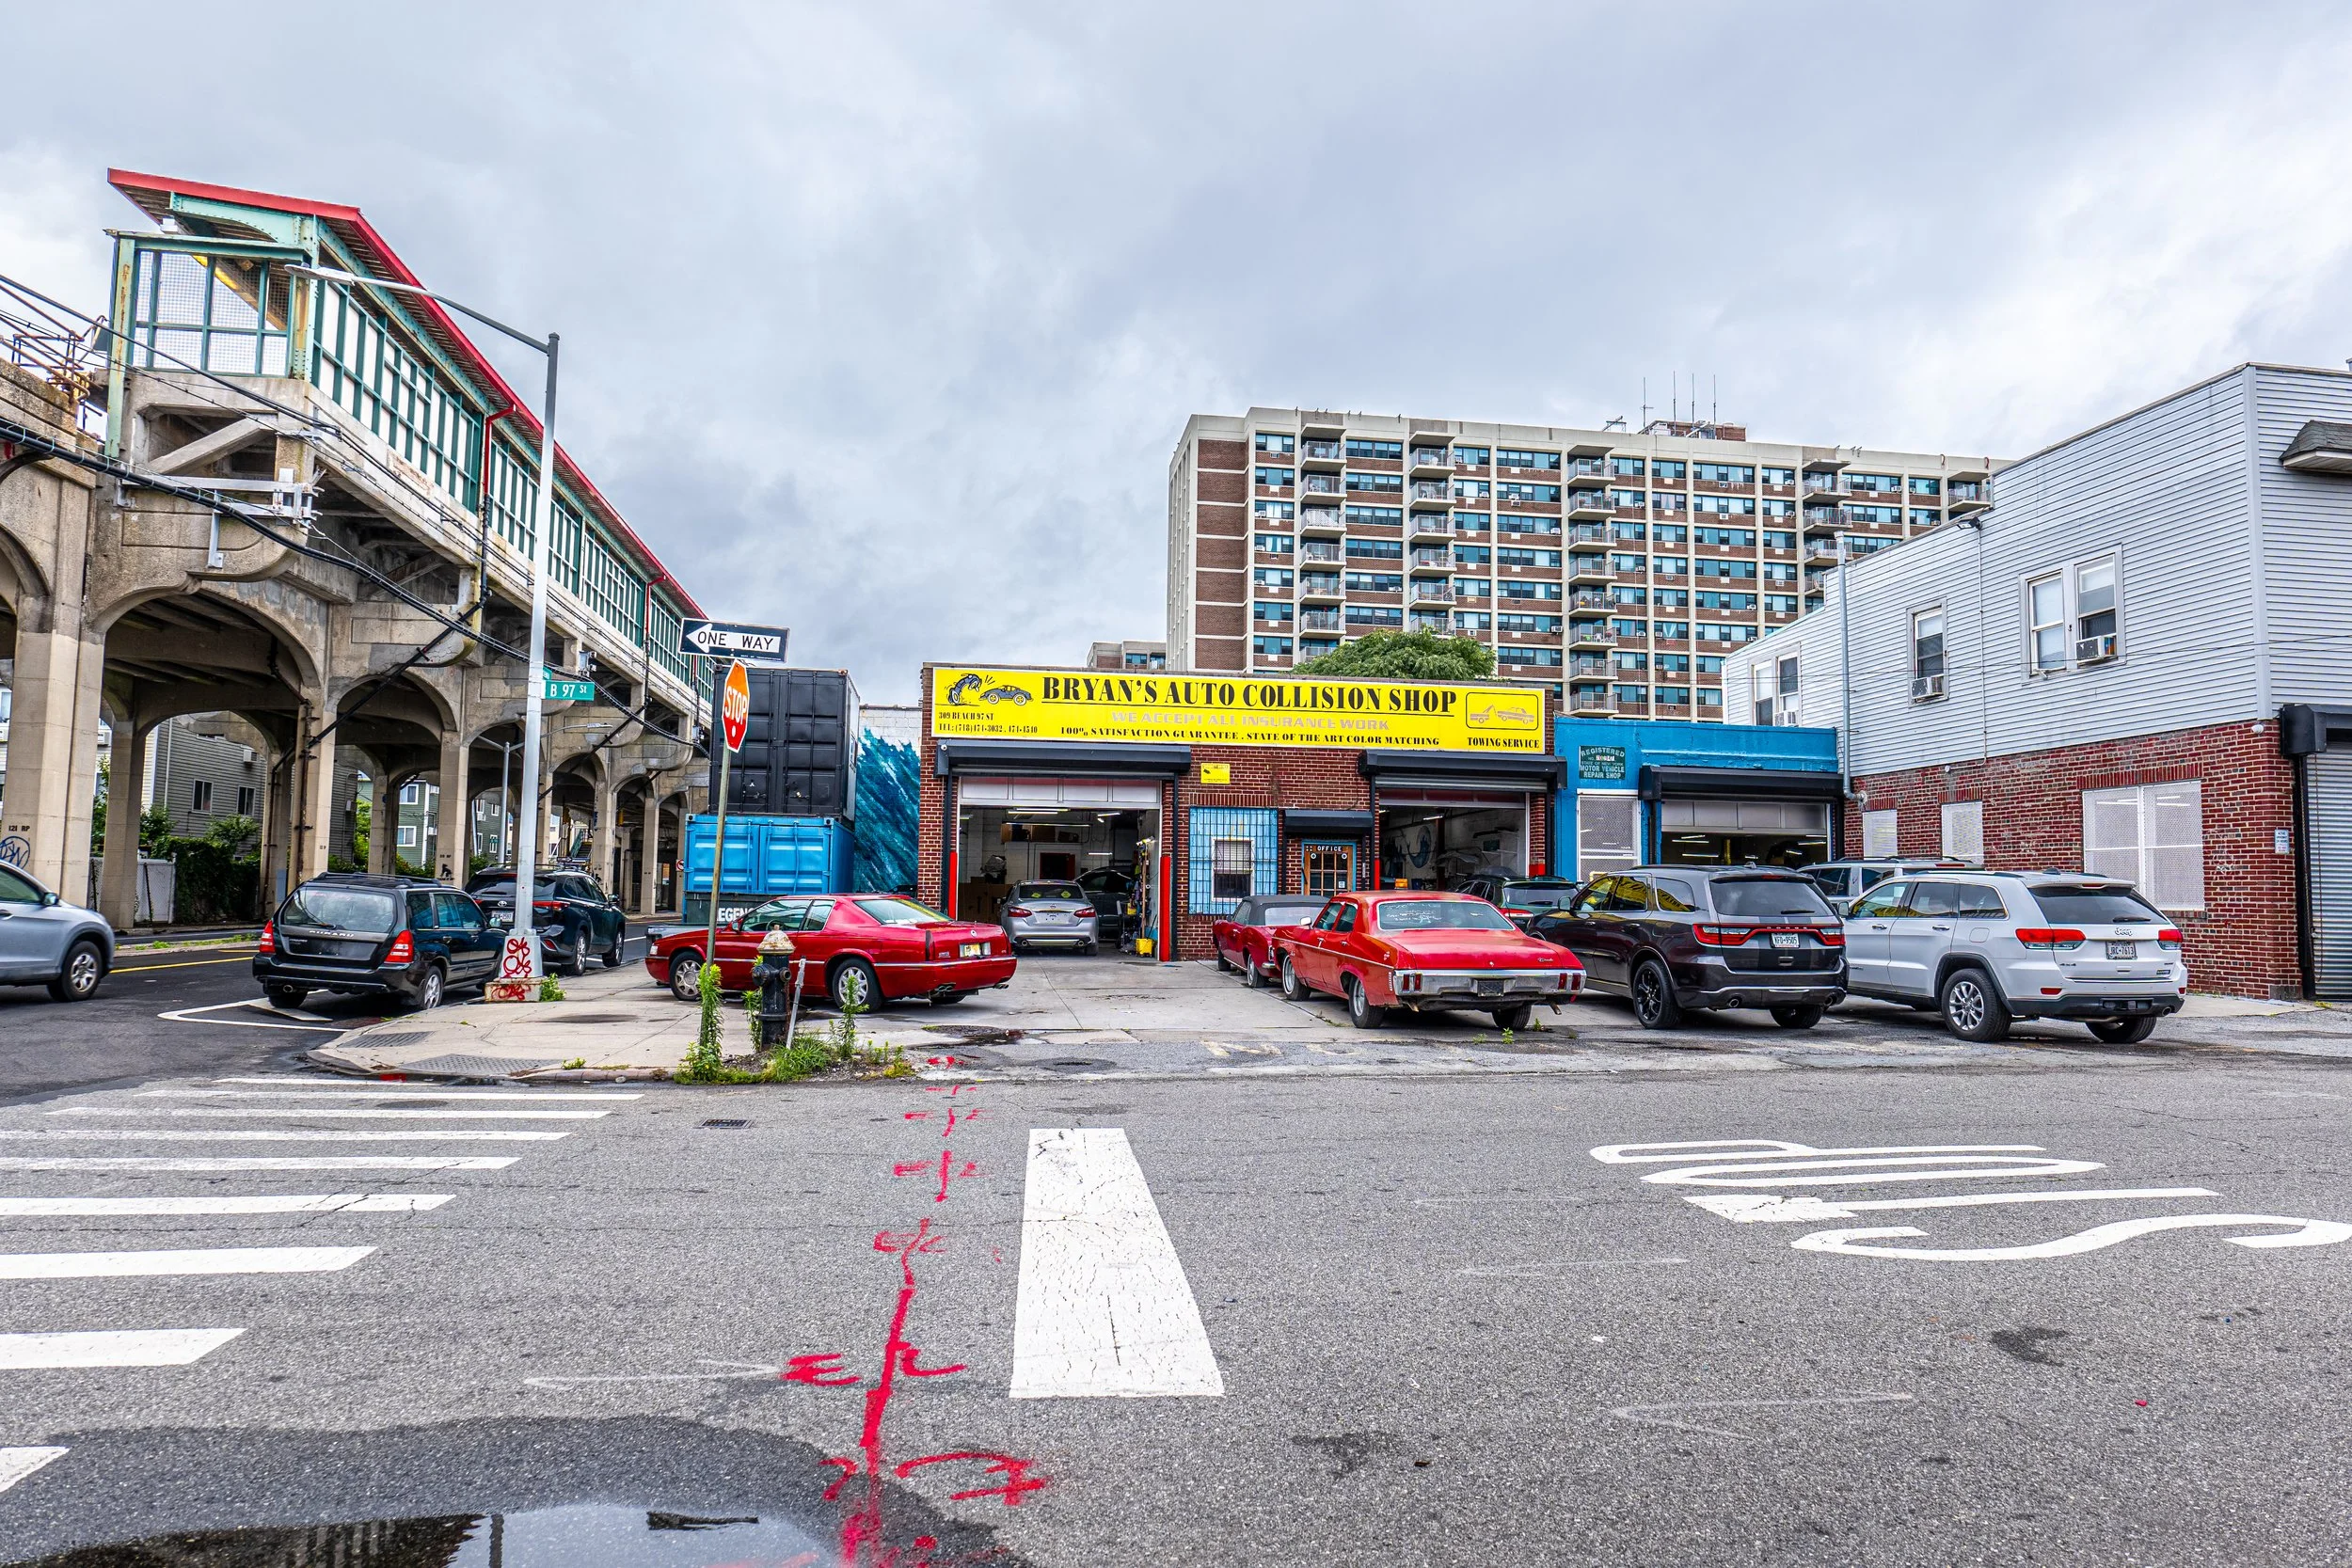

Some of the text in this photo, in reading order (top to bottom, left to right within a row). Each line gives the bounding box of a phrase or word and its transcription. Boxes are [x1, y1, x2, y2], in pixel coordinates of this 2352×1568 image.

[697, 631, 774, 650] ONE WAY
[550, 684, 587, 697] B 97 St
[1042, 676, 1457, 713] BRYAN'S AUTO COLLISION SHOP
[724, 685, 747, 725] STOP
[938, 711, 951, 720] 309
[1112, 711, 1390, 730] WE ACCEPT ALL INSURANCE WORK
[1060, 726, 1089, 736] 100%
[1090, 728, 1170, 737] SATISFACTION
[1247, 732, 1279, 741] STATE
[1282, 733, 1296, 741] OF
[1298, 734, 1321, 742] THE
[1323, 735, 1344, 743] ART
[1346, 735, 1382, 744] COLOR
[1385, 736, 1440, 746] MATCHING
[1468, 736, 1540, 749] TOWING SERVICE
[1581, 747, 1625, 758] REGISTERED
[2114, 927, 2133, 937] Jeep
